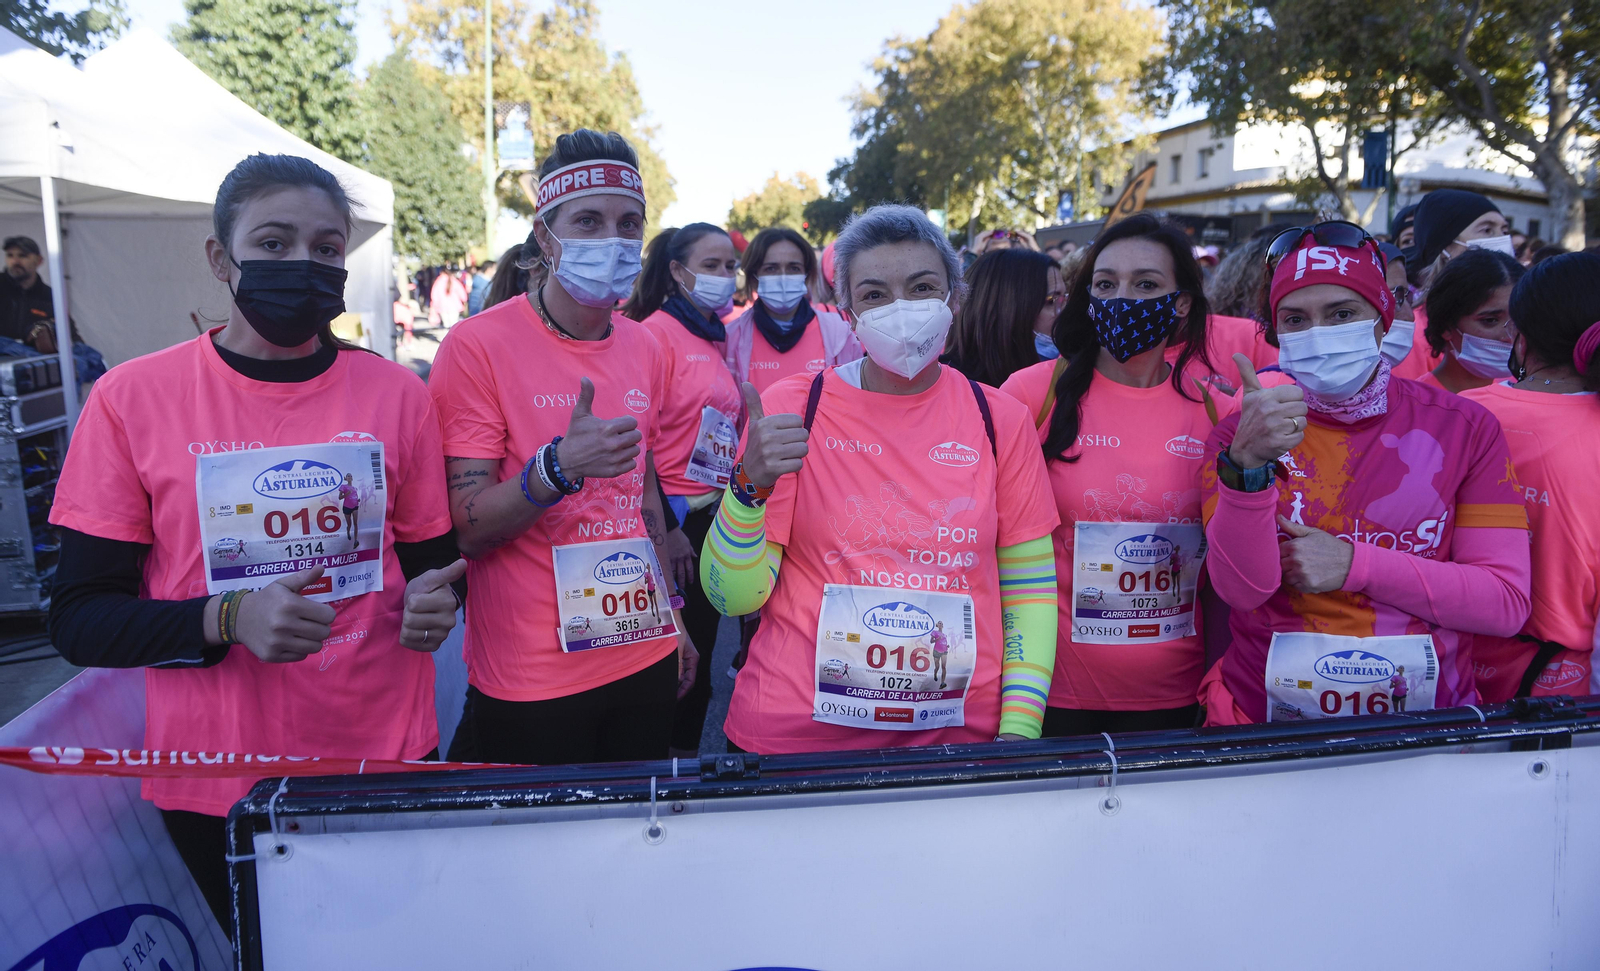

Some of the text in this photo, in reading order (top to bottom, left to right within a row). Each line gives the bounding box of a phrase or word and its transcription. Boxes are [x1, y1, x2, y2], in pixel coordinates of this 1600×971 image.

[537, 167, 645, 208] COMPRESSP
[533, 393, 579, 408] OYSH
[825, 436, 883, 456] OYSHO
[1077, 434, 1121, 448] YSHO
[713, 442, 736, 460] 016
[933, 449, 977, 462] ASTURIANA
[718, 460, 730, 468] 410
[631, 473, 644, 488] PO
[689, 468, 715, 481] OYSHO
[260, 475, 337, 492] ASTURIANA
[263, 505, 342, 539] 016
[937, 526, 978, 544] POR
[284, 541, 325, 558] 1314
[1120, 545, 1170, 557] ASTURIANA
[245, 552, 359, 577] CARRERA DE LA MUJER
[907, 549, 974, 568] TODAS
[348, 573, 373, 584] ZURICH
[598, 565, 643, 579] ASTURIANA
[860, 569, 969, 590] NOSOTRAS
[1118, 570, 1171, 593] 016
[601, 588, 649, 617] 016
[1130, 597, 1158, 609] 1073
[1101, 606, 1181, 619] CARRERA DE LA MUJER
[615, 618, 640, 632] 3615
[868, 612, 930, 631] ASTURIANA
[345, 630, 368, 642] 2021
[590, 627, 664, 648] CARRERA DE LA MUJER
[1079, 625, 1123, 637] OYSHO
[866, 643, 931, 673] 016
[1320, 660, 1390, 677] ASTURIANA
[879, 676, 913, 690] 1072
[846, 687, 943, 701] CARRERA DE LA MUJER
[1319, 689, 1390, 716] 016
[820, 701, 868, 719] OYSHO
[930, 708, 955, 718] ZURICH
[121, 930, 157, 971] ERA
